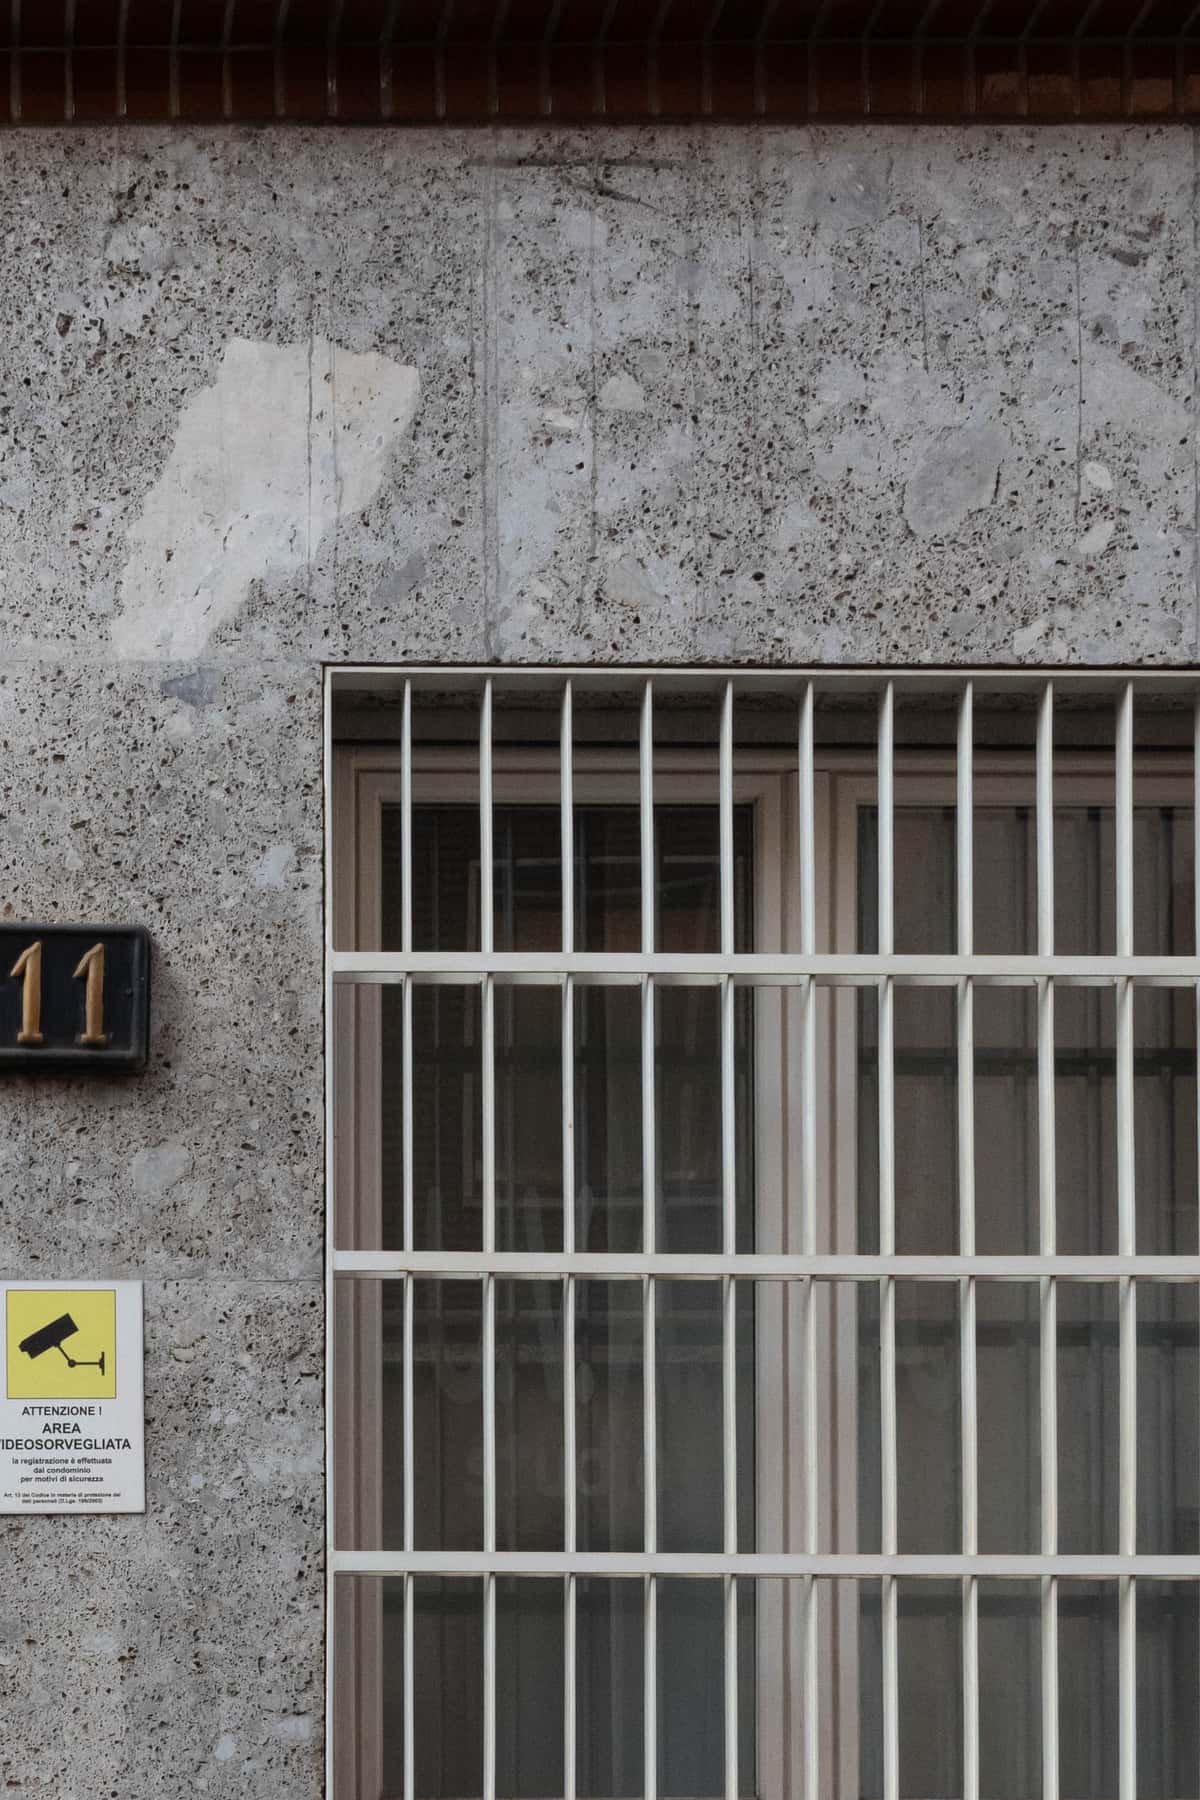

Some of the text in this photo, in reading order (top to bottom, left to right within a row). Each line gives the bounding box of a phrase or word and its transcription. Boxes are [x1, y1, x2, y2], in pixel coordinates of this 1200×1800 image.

[9, 941, 106, 1042] 11
[21, 1406, 96, 1416] ATTENZIONE
[42, 1422, 82, 1434] AREA
[20, 1457, 69, 1466] registrazione
[77, 1457, 112, 1465] effettuata
[33, 1466, 91, 1474] dal condominio
